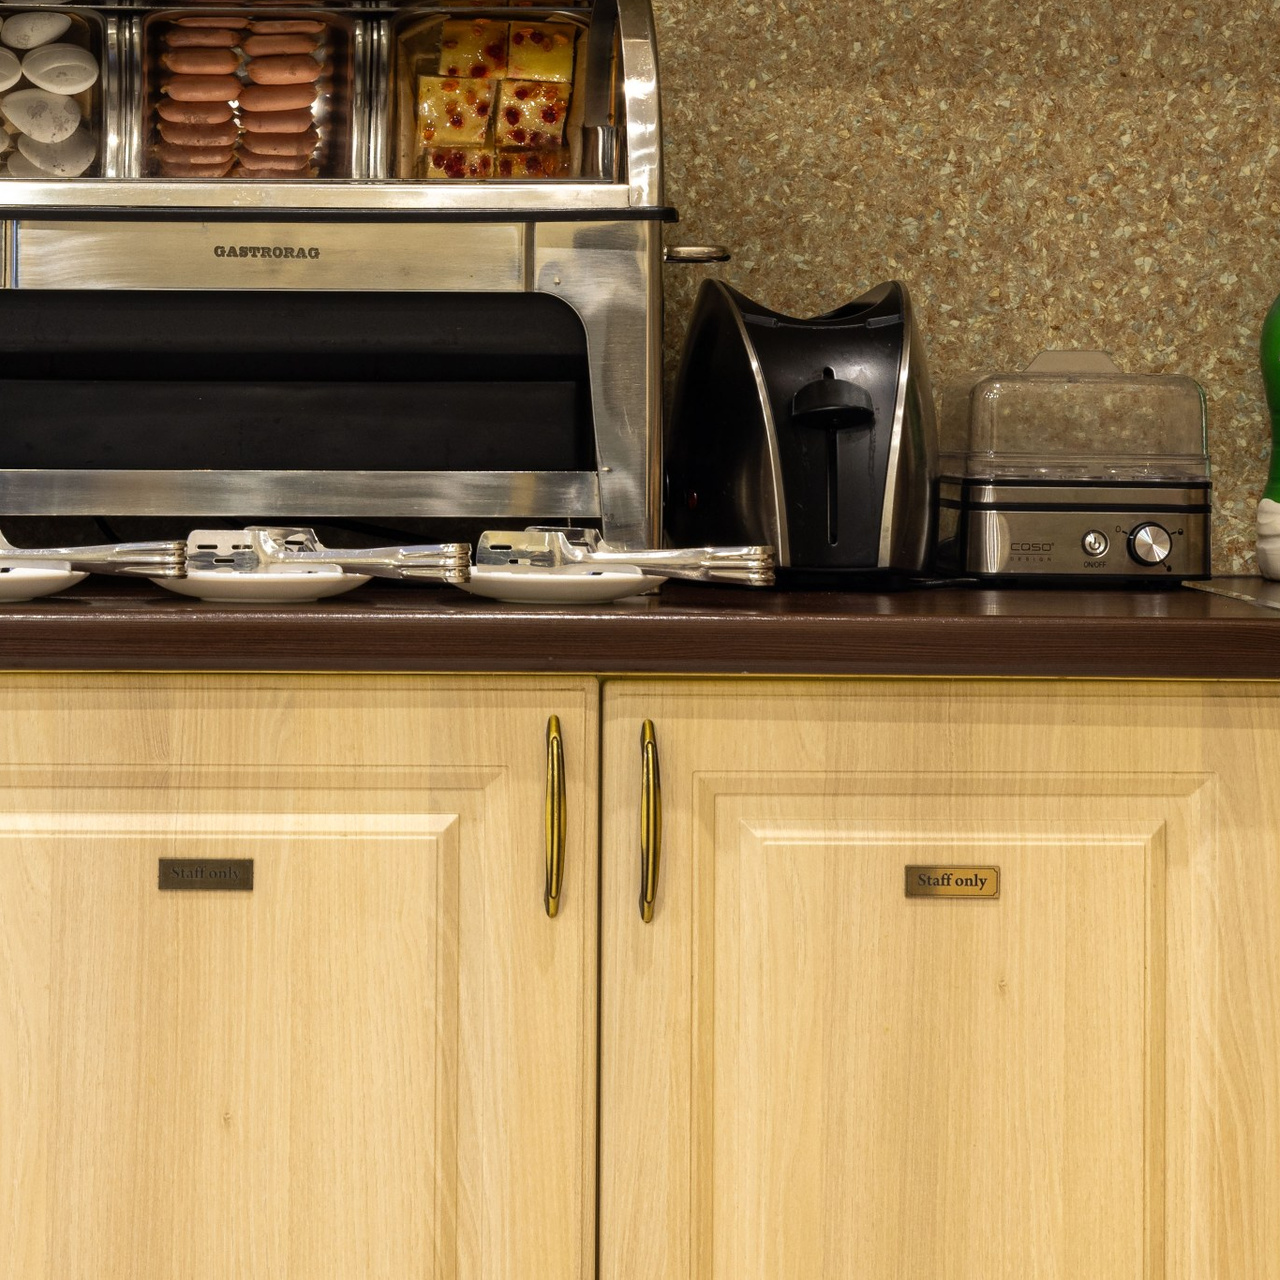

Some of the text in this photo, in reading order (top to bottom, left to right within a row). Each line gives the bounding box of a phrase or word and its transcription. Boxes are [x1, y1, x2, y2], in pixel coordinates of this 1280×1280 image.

[214, 246, 320, 259] GASTRORAG
[172, 866, 240, 881] Staff only
[918, 873, 987, 890] Staff only
